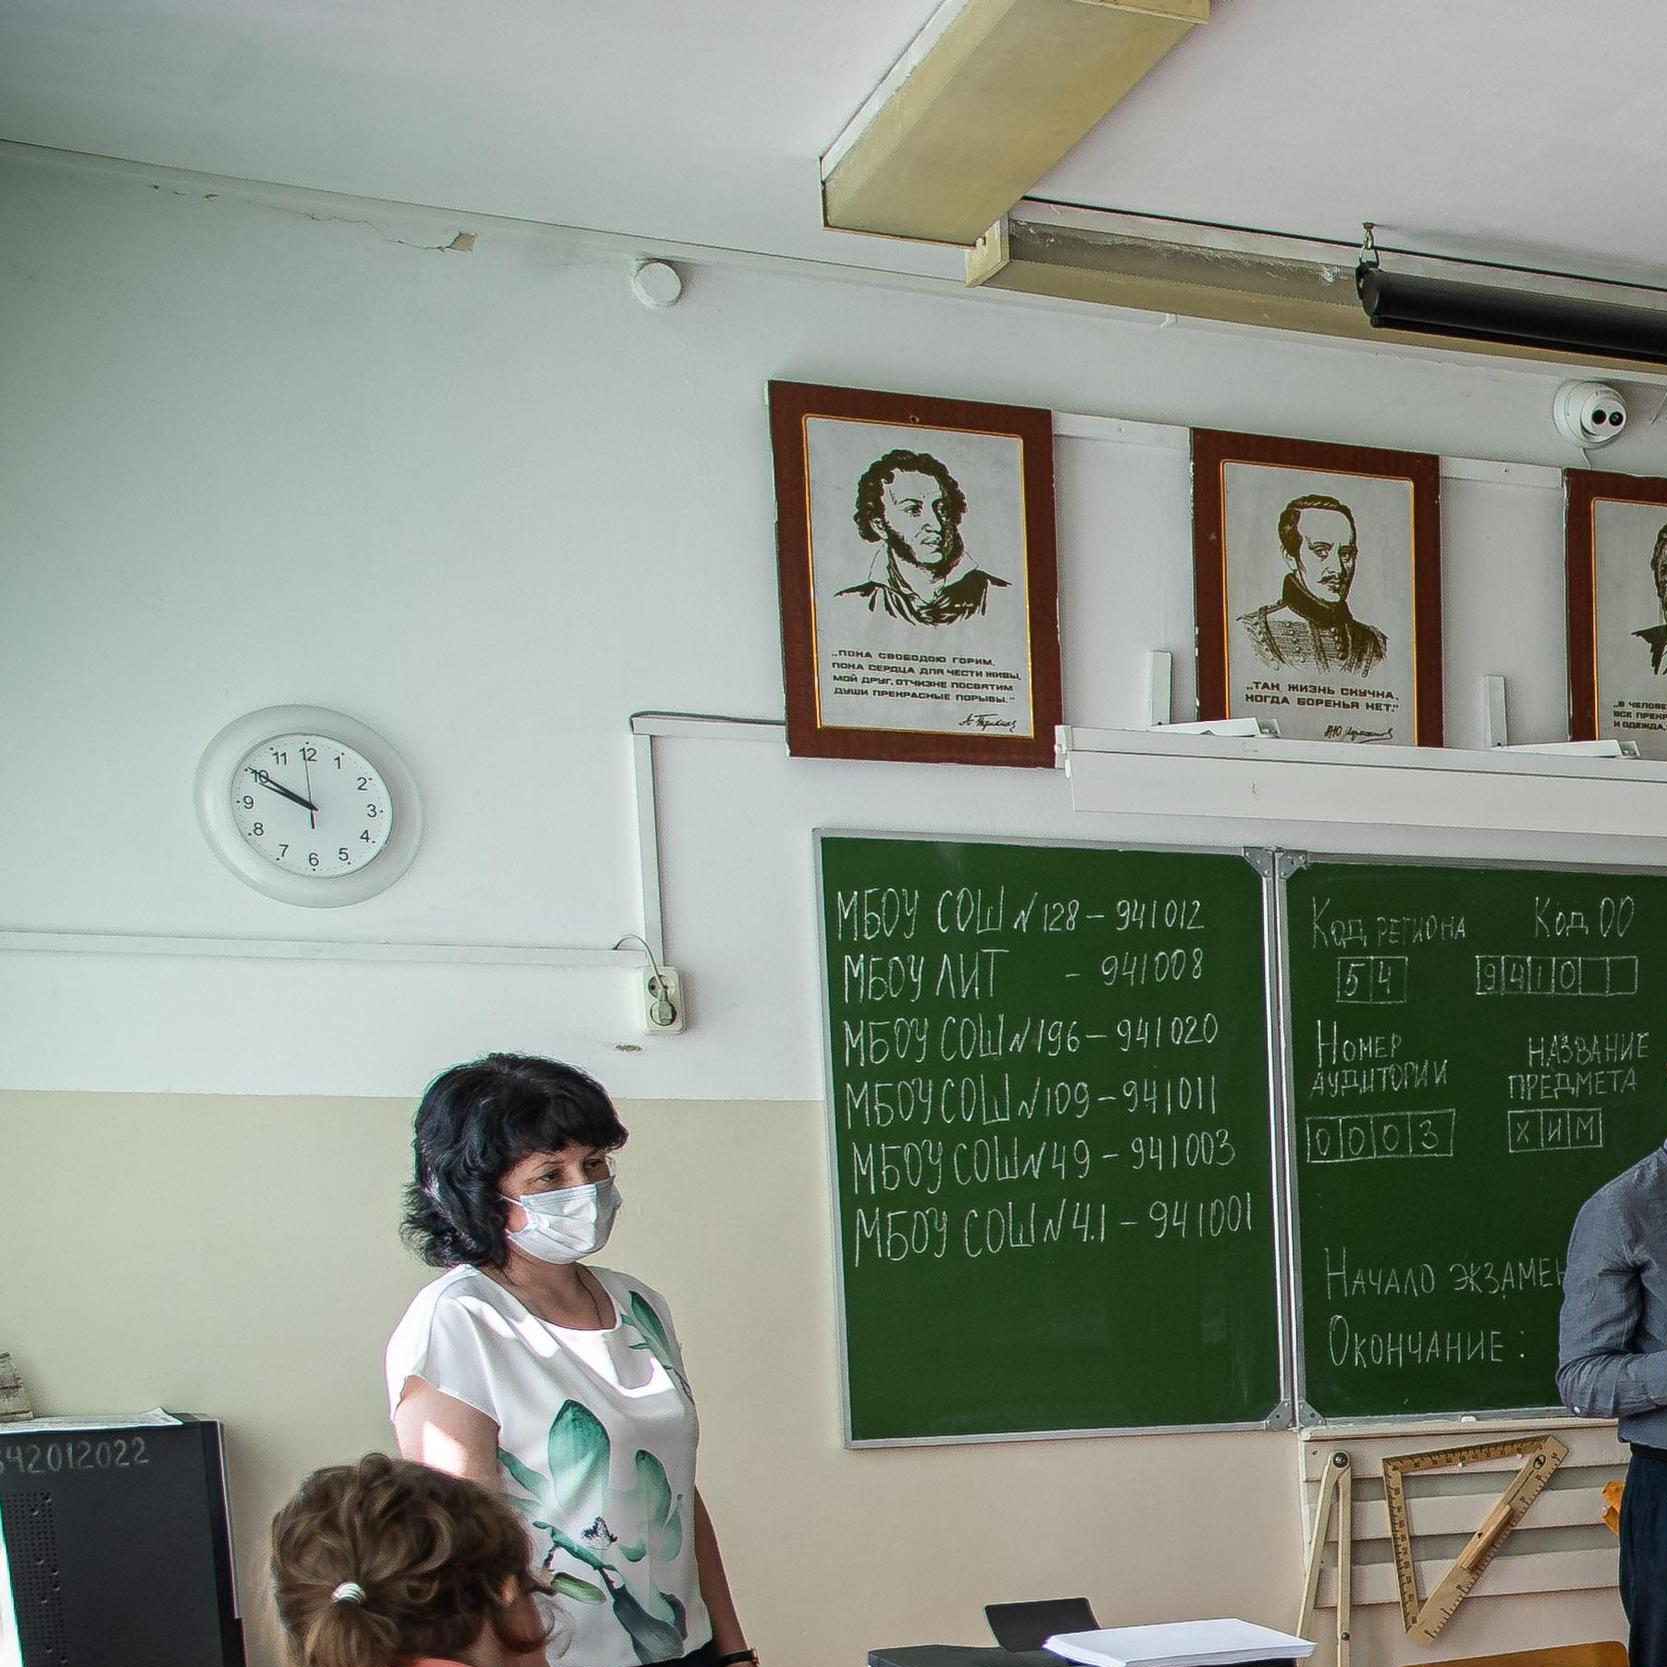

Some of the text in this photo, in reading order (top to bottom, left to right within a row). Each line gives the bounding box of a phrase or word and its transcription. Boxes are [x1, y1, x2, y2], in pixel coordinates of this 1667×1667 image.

[878, 652, 947, 664] СВОБОДОЮ
[868, 664, 915, 675] СЕРДЦА
[918, 667, 944, 676] ДЛЯ
[946, 668, 983, 678] ЧЕСТИ
[832, 673, 858, 683] МОЙ
[951, 681, 1013, 692] ПОСВЯТИМ
[1287, 683, 1336, 695] ЖИЗНЬ
[1296, 697, 1360, 710] БОРЕНЬЯ
[272, 751, 288, 766] 11
[299, 747, 317, 762] 12
[333, 756, 342, 770] 1
[356, 776, 369, 791] 2
[242, 795, 255, 810] 9
[366, 804, 378, 818] 3
[252, 821, 265, 837] 8
[359, 829, 370, 843] 4
[278, 843, 290, 858] 7
[338, 847, 350, 862] 5
[308, 852, 320, 867] 6
[837, 888, 919, 941] МБОУ
[937, 885, 1004, 934] СОШ
[1115, 899, 1205, 932] 941012
[844, 947, 1203, 1003] МБОУ ЛИТ 941008
[843, 1017, 929, 1067] МБОУ
[940, 1013, 1005, 1061] СОШ
[1117, 1013, 1218, 1052] 941020
[1528, 1031, 1651, 1068] НАЗВАНИЕ
[1311, 1058, 1449, 1099] АУДИТОРИИ
[1508, 1067, 1639, 1099] ПРЕДМЕТА
[846, 1076, 933, 1129] МБОУ
[941, 1073, 1010, 1126] СОШ
[1123, 1074, 1216, 1116] 941011
[852, 1140, 942, 1195] МБОУ
[953, 1136, 1018, 1183] СОШ
[1130, 1128, 1236, 1170] 941003
[855, 1206, 948, 1268] МБОУ
[965, 1201, 1036, 1258] СОШ
[1149, 1192, 1252, 1241] 941001
